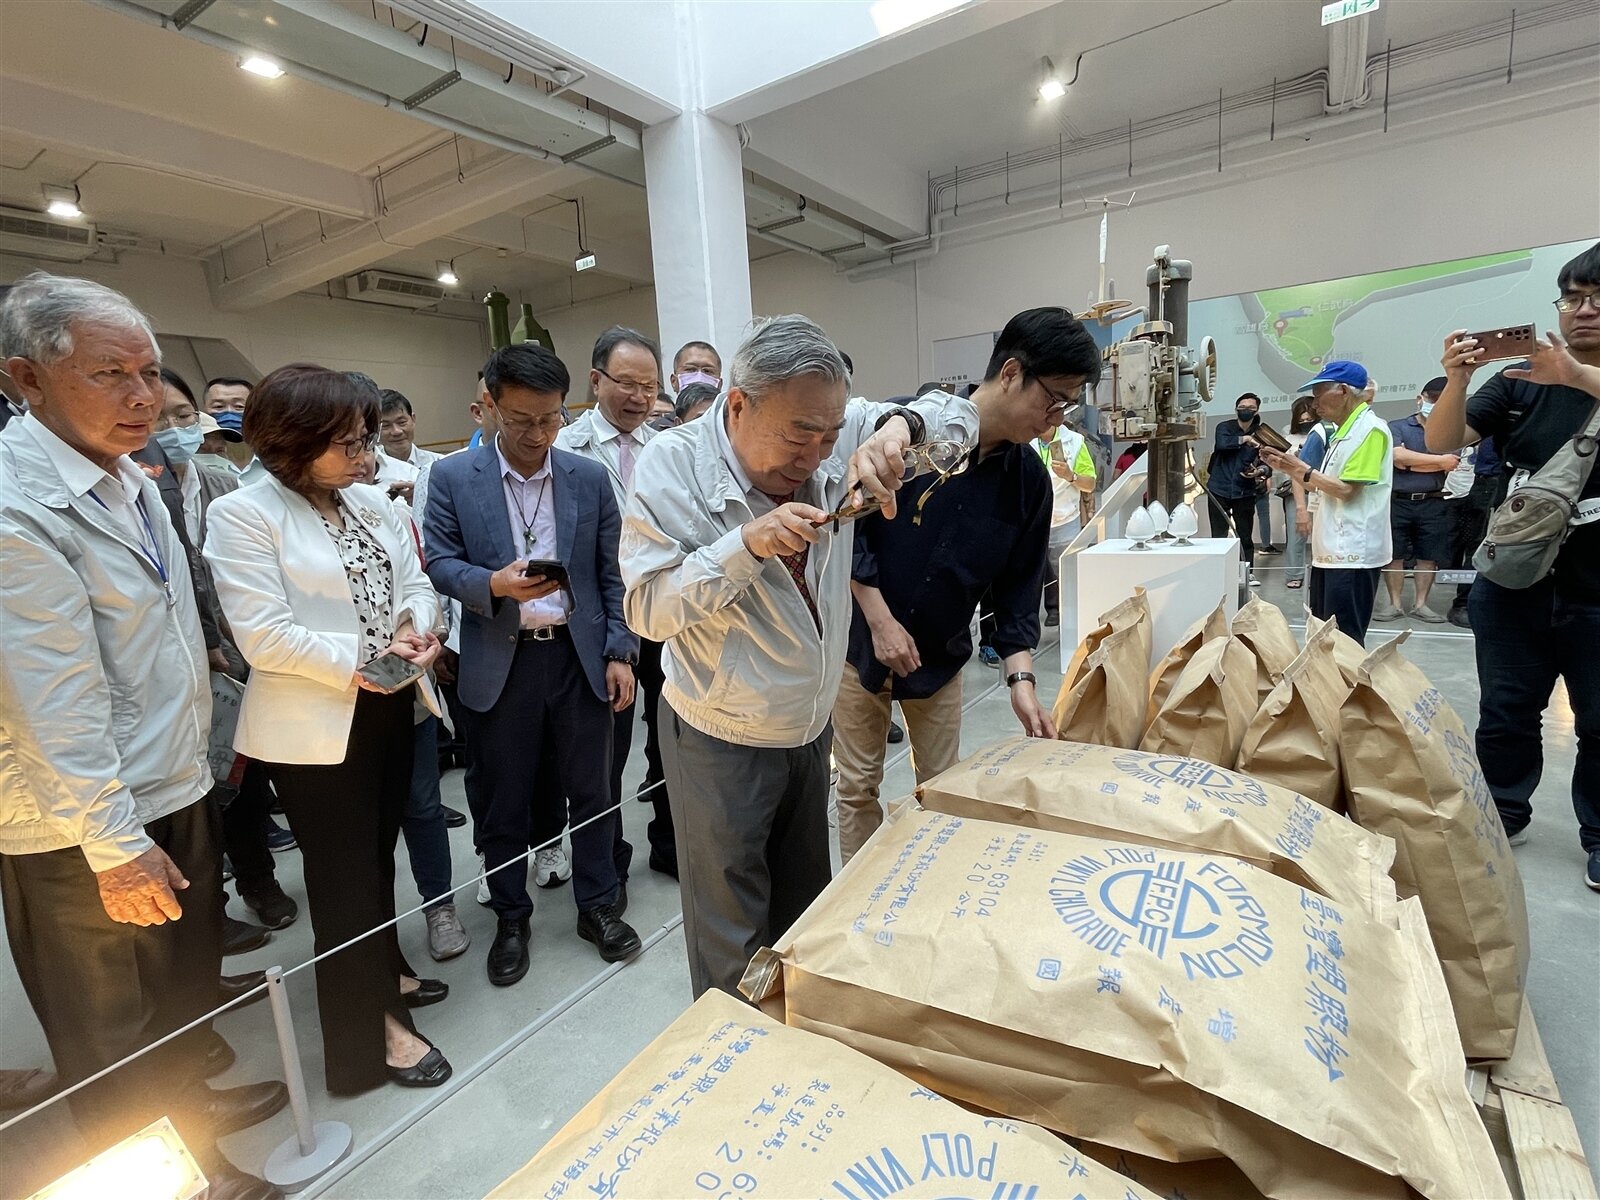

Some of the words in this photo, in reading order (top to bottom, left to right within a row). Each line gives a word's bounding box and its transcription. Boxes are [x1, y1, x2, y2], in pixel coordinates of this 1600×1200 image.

[1050, 855, 1108, 886] VINYL
[1104, 847, 1156, 865] POLY
[974, 871, 1009, 918] 63104
[1049, 888, 1132, 958] CHLORIDE
[1180, 861, 1273, 982] FORMOLON
[921, 1132, 998, 1182] POLY
